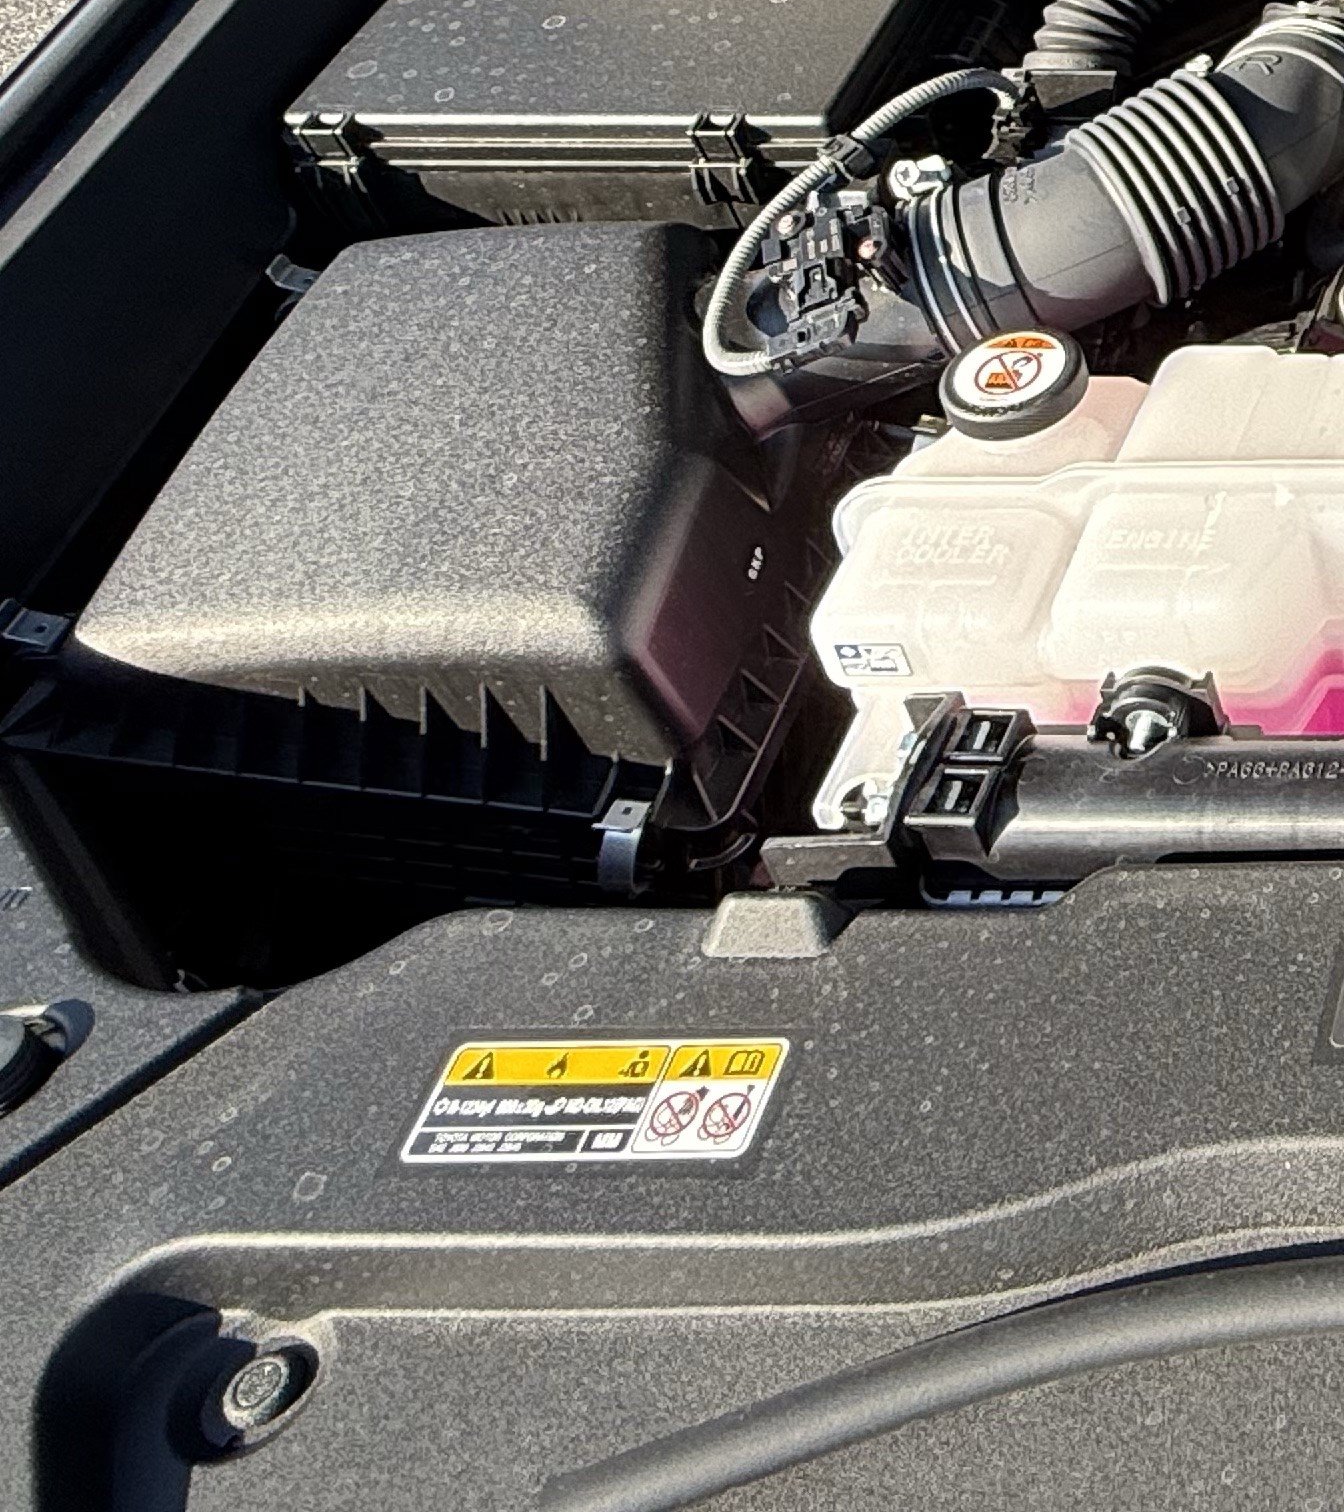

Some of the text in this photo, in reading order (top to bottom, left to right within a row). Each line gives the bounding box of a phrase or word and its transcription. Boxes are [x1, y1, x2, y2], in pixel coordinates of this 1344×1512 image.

[901, 525, 997, 546] INTER
[1104, 529, 1215, 549] ENGINE
[896, 544, 1011, 565] COOLER
